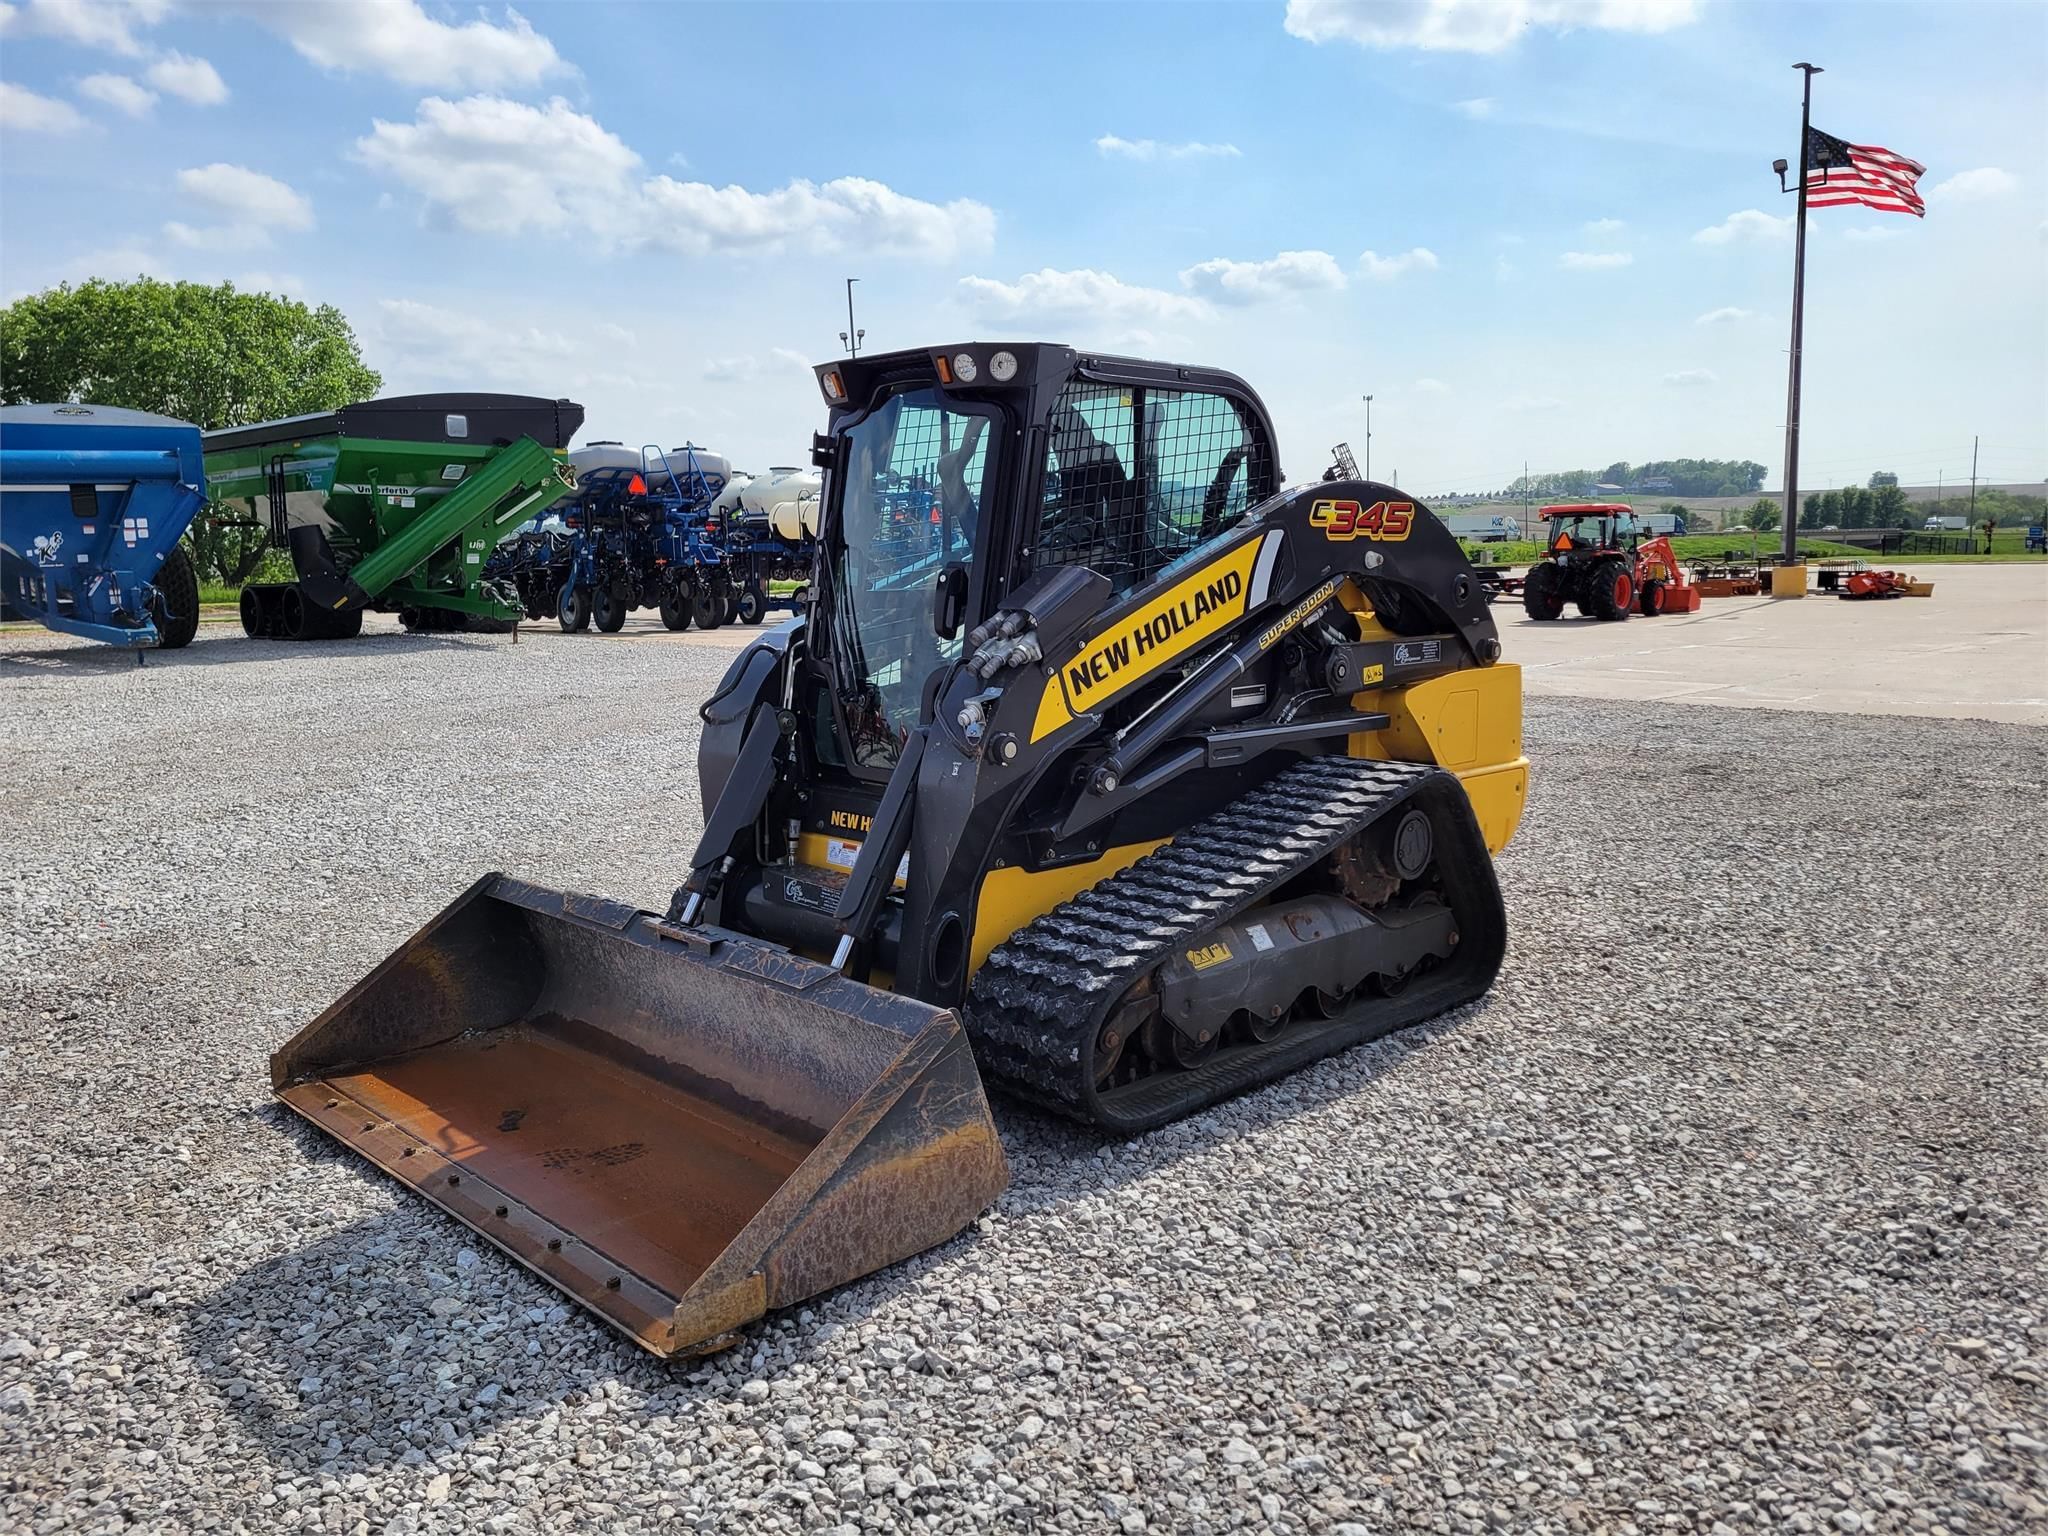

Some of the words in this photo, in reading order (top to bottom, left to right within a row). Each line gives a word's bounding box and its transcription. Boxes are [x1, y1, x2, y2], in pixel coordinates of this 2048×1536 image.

[1309, 499, 1415, 542] C345
[1069, 635, 1130, 697] NEW
[1133, 569, 1242, 657] HOLLAND
[1259, 608, 1301, 650] SUPER
[1299, 581, 1334, 617] BOOM
[831, 810, 860, 830] NEW
